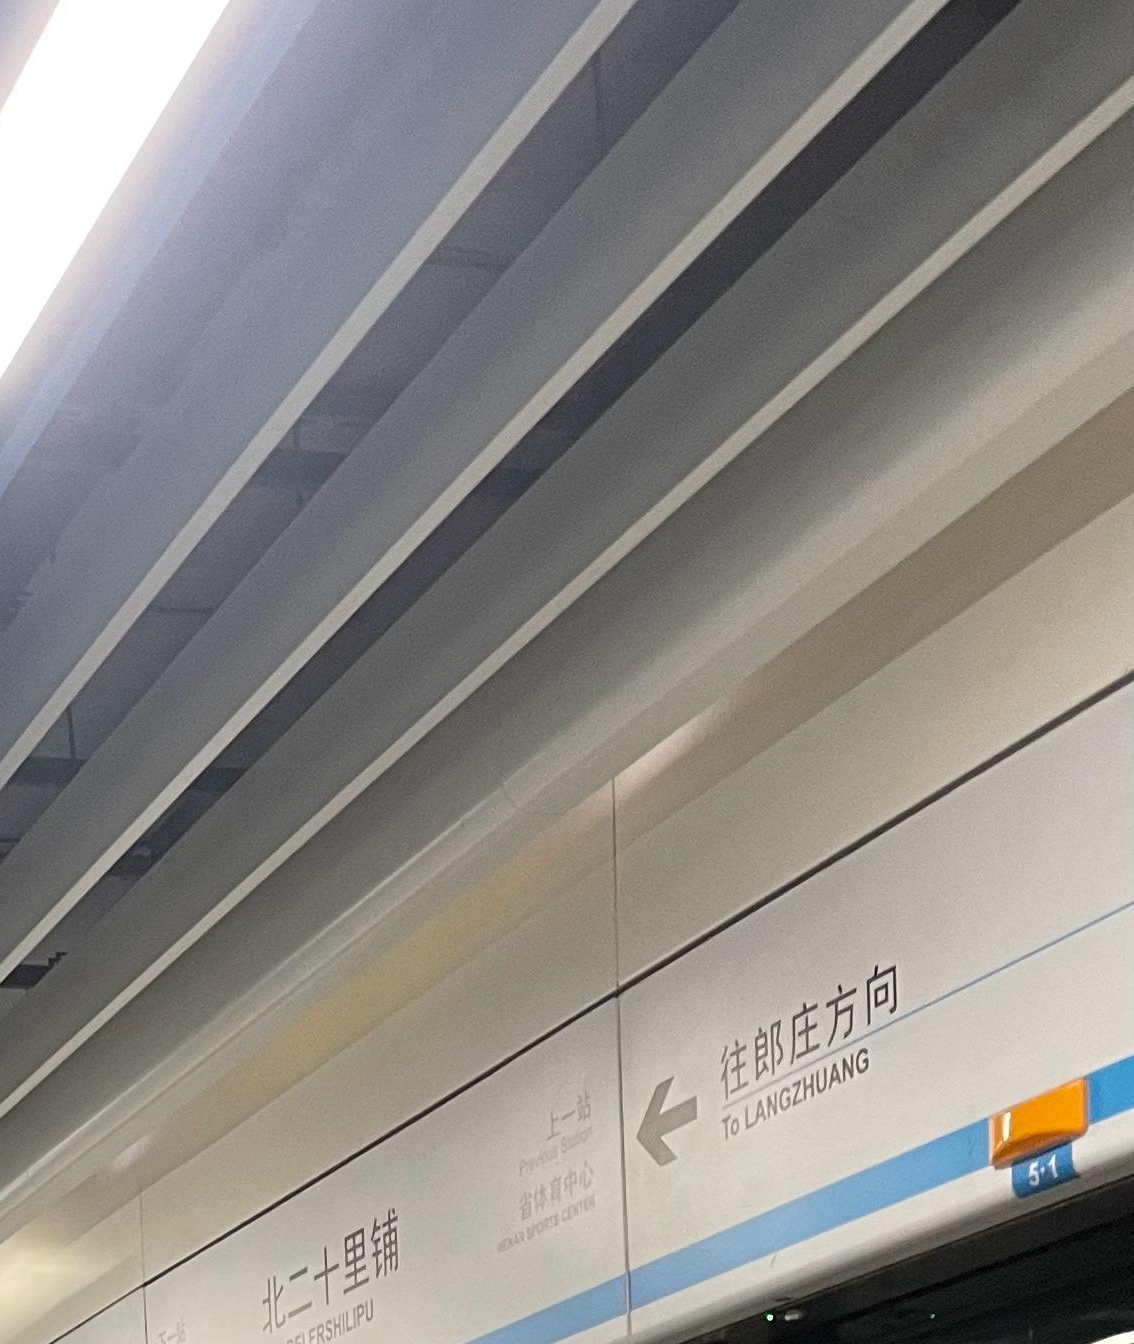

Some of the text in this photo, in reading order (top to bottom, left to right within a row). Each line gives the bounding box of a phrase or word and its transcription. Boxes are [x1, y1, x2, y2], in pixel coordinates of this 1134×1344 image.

[720, 964, 897, 1100] 往郎庄方向
[546, 1090, 592, 1141] 上一站
[722, 1047, 870, 1140] To LANGZHUANG
[519, 1160, 594, 1221] 省体育中心
[526, 1212, 559, 1241] SPORTS
[561, 1194, 596, 1222] CENTER
[262, 1208, 399, 1333] 北二十里铺
